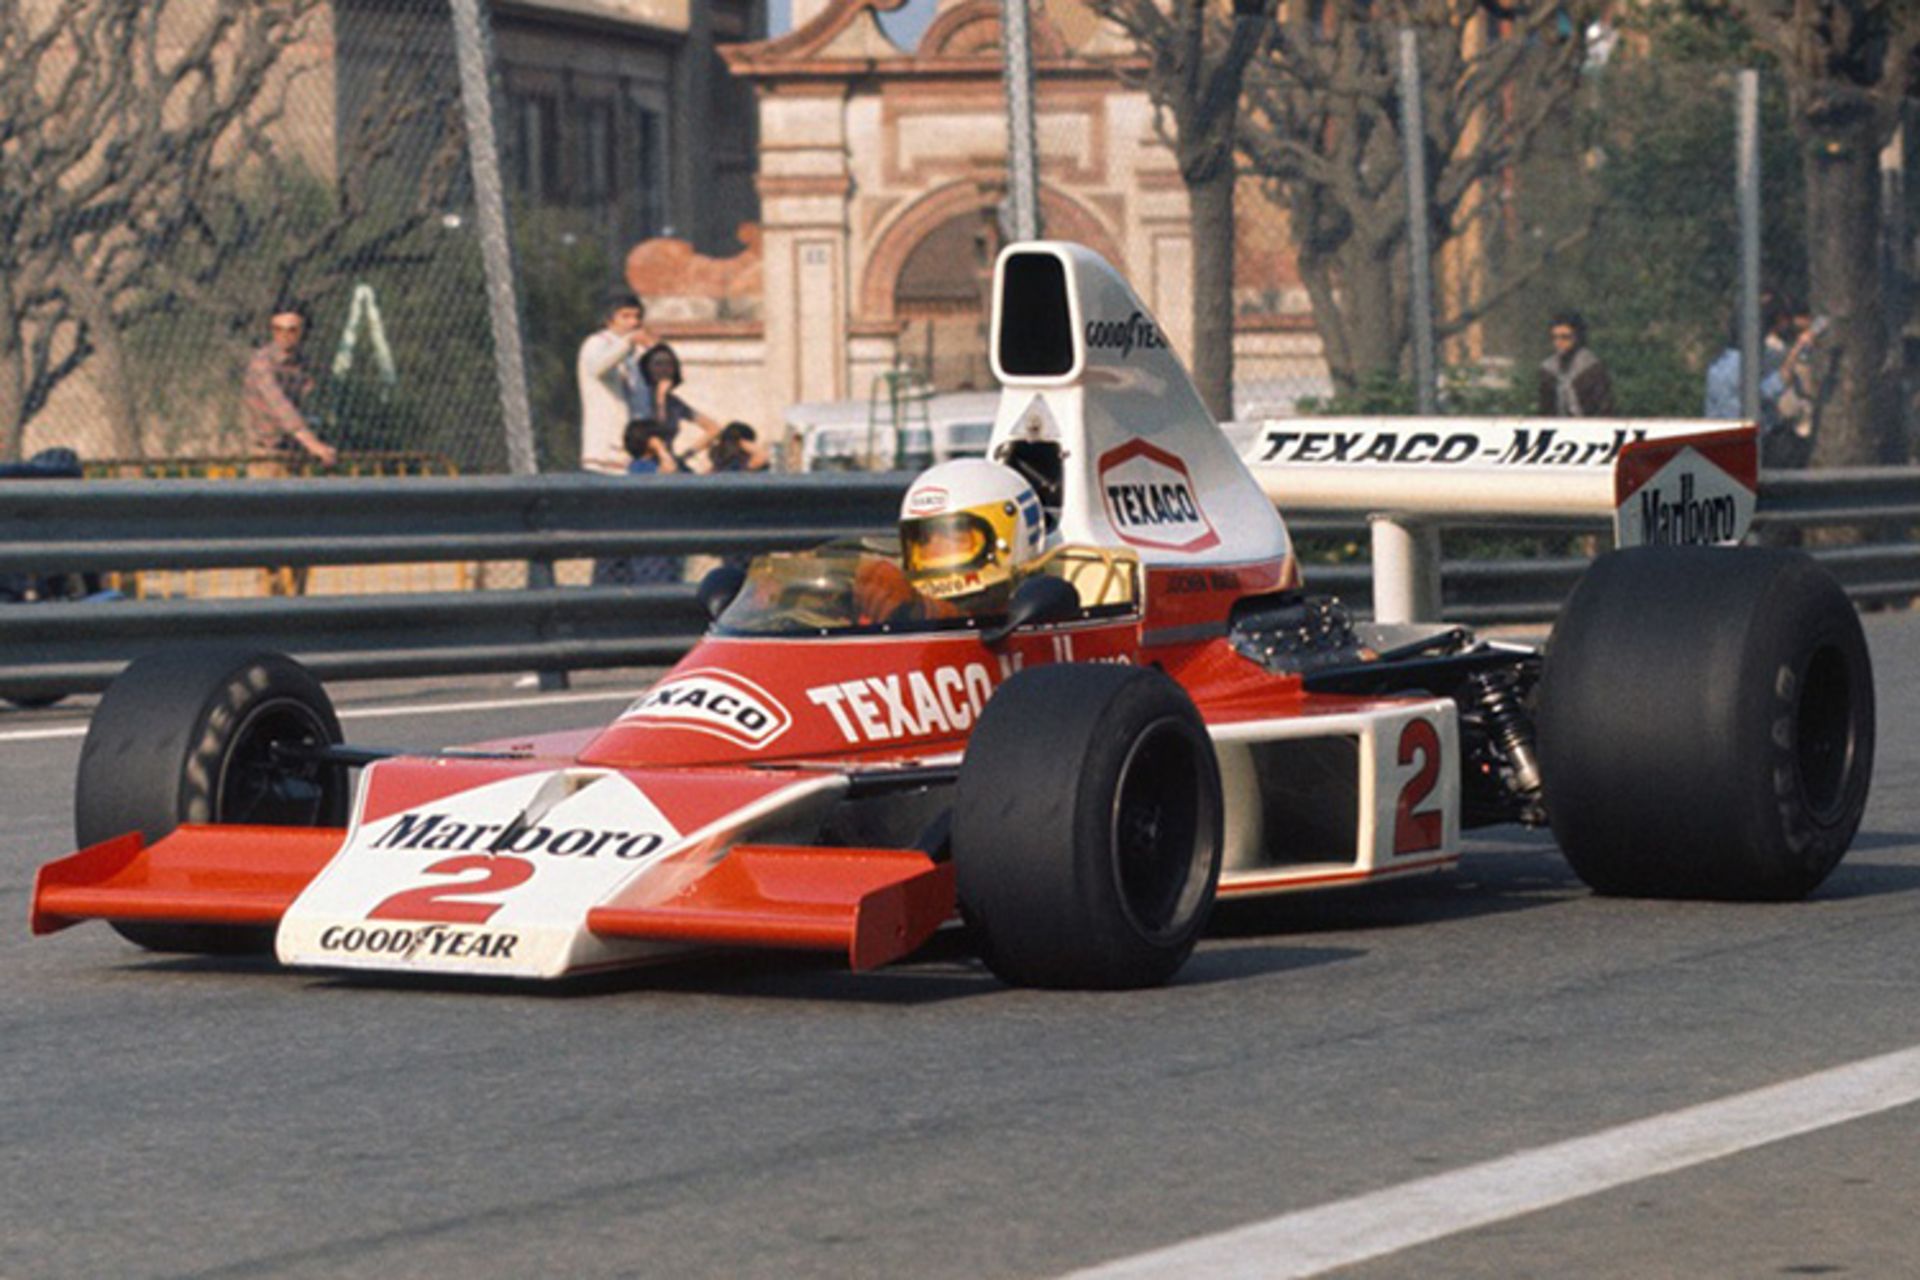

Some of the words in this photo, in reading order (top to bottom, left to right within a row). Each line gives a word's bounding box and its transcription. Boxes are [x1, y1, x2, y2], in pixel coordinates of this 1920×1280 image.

[1260, 429, 1646, 465] TEXACO-Marl
[1107, 483, 1199, 526] TEXACO
[1640, 473, 1736, 545] Marlboro
[806, 663, 994, 742] TEXACO
[1392, 716, 1443, 857] 2
[370, 813, 663, 860] Marlboro
[365, 854, 536, 925] 2
[320, 924, 518, 960] GOODYEAR
